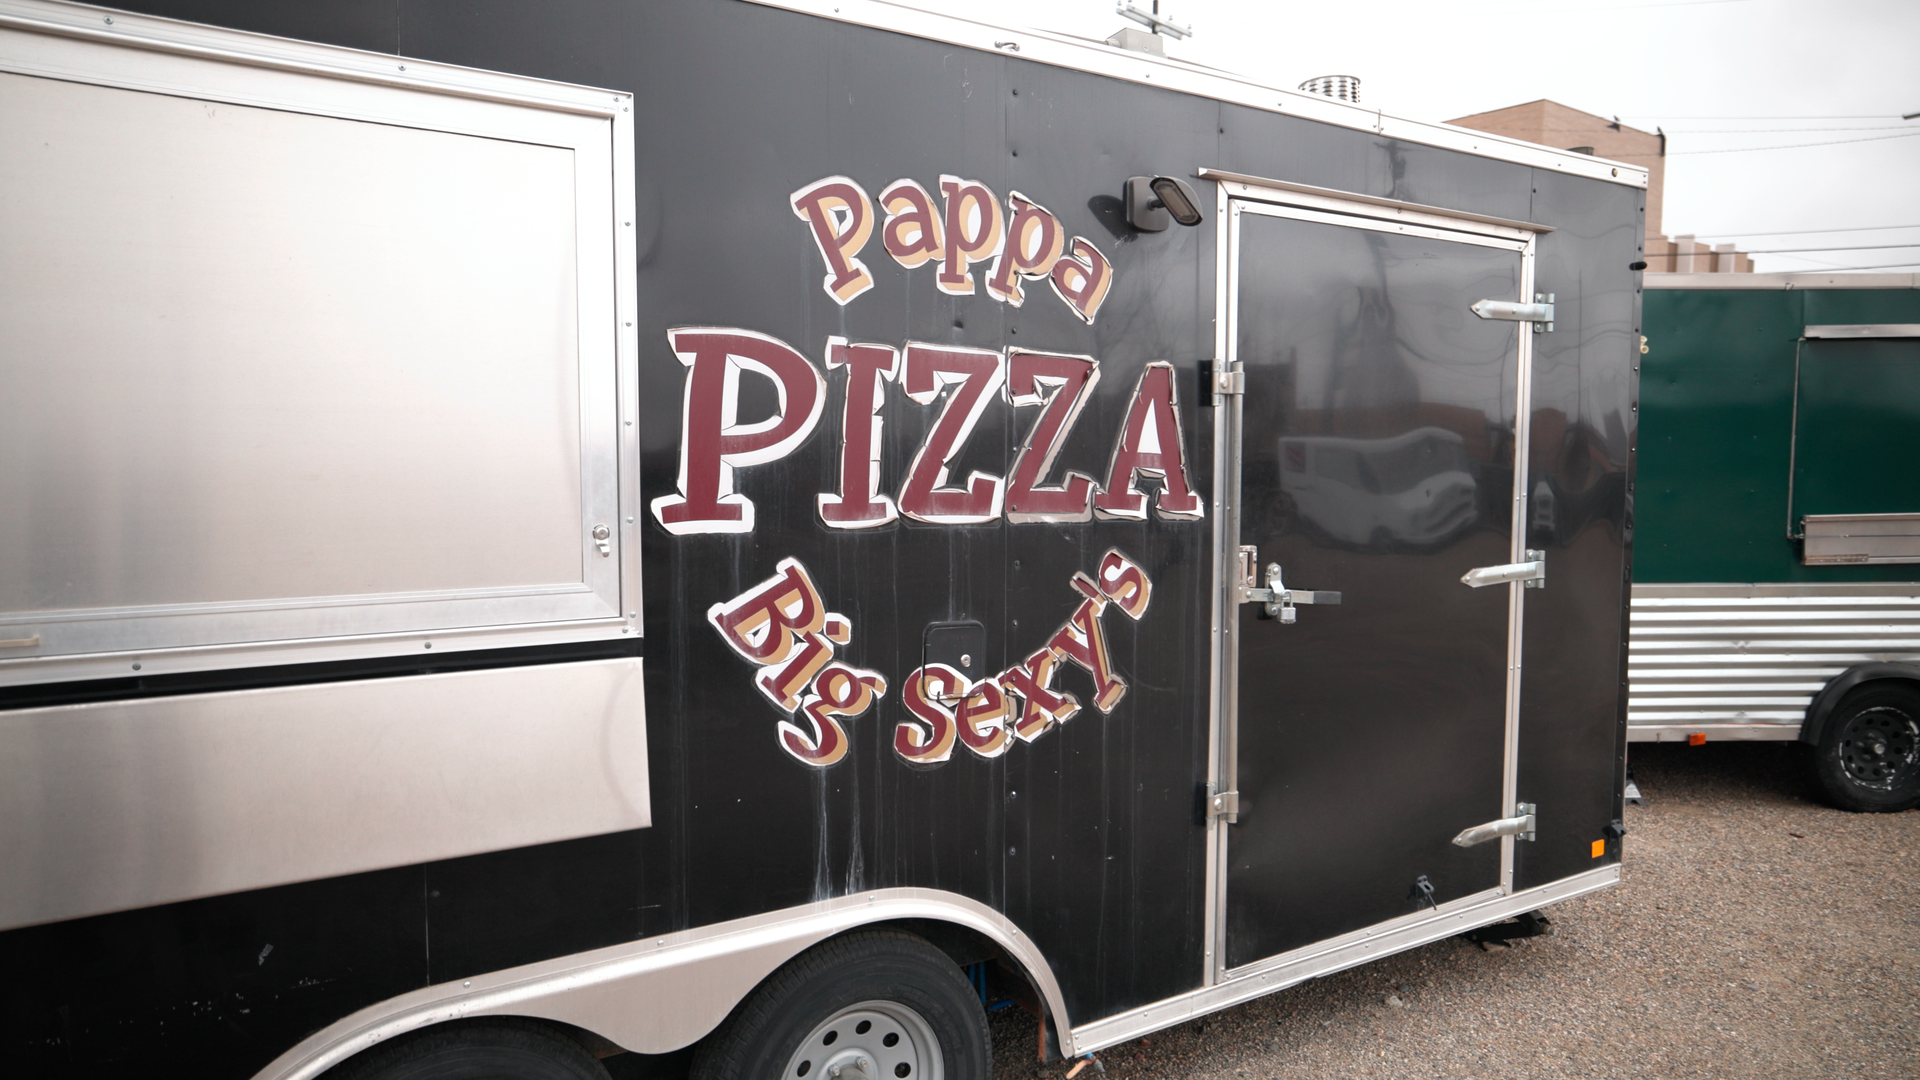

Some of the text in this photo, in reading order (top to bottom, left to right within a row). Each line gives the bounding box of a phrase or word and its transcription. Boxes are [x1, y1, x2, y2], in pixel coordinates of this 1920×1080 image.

[791, 175, 1112, 323] Pappa
[651, 327, 1204, 535] PIZZA
[708, 549, 1153, 766] Big Sexy's
